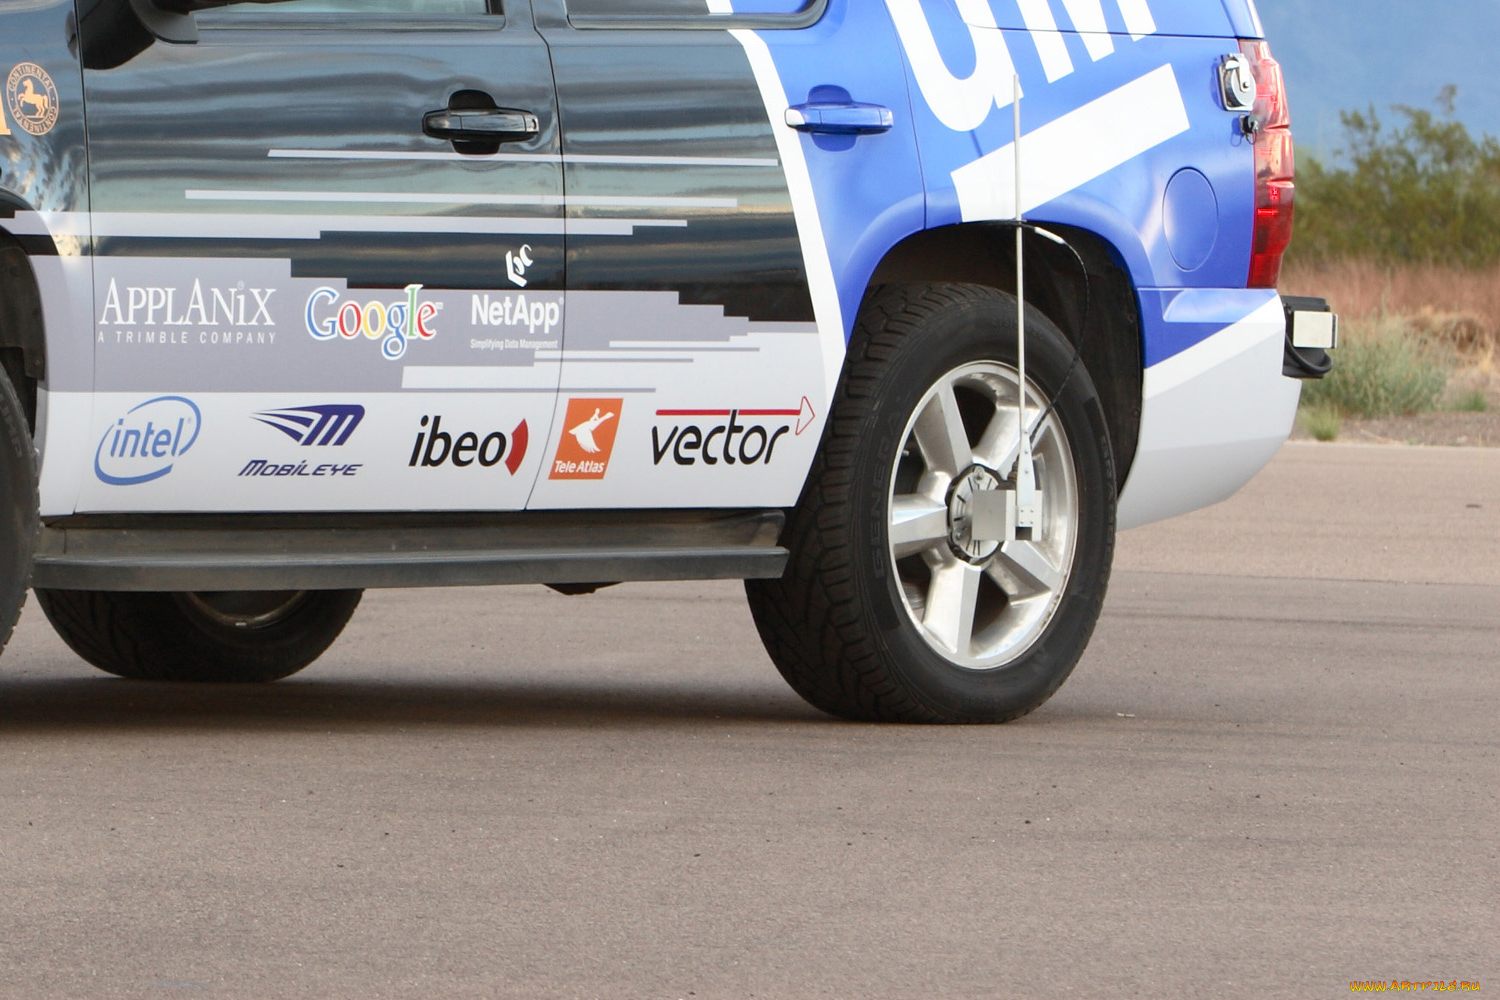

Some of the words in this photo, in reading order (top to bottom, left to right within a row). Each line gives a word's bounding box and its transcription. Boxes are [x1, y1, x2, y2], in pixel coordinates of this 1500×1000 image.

[304, 284, 438, 360] Google
[471, 294, 560, 334] NetApp
[98, 331, 104, 343] A
[116, 331, 188, 344] TRIMBLE
[200, 331, 276, 344] COMPANY
[110, 417, 185, 458] intel
[408, 415, 506, 467] ibeo
[651, 409, 790, 466] vector
[555, 460, 577, 473] Tele
[576, 460, 605, 473] Atlas
